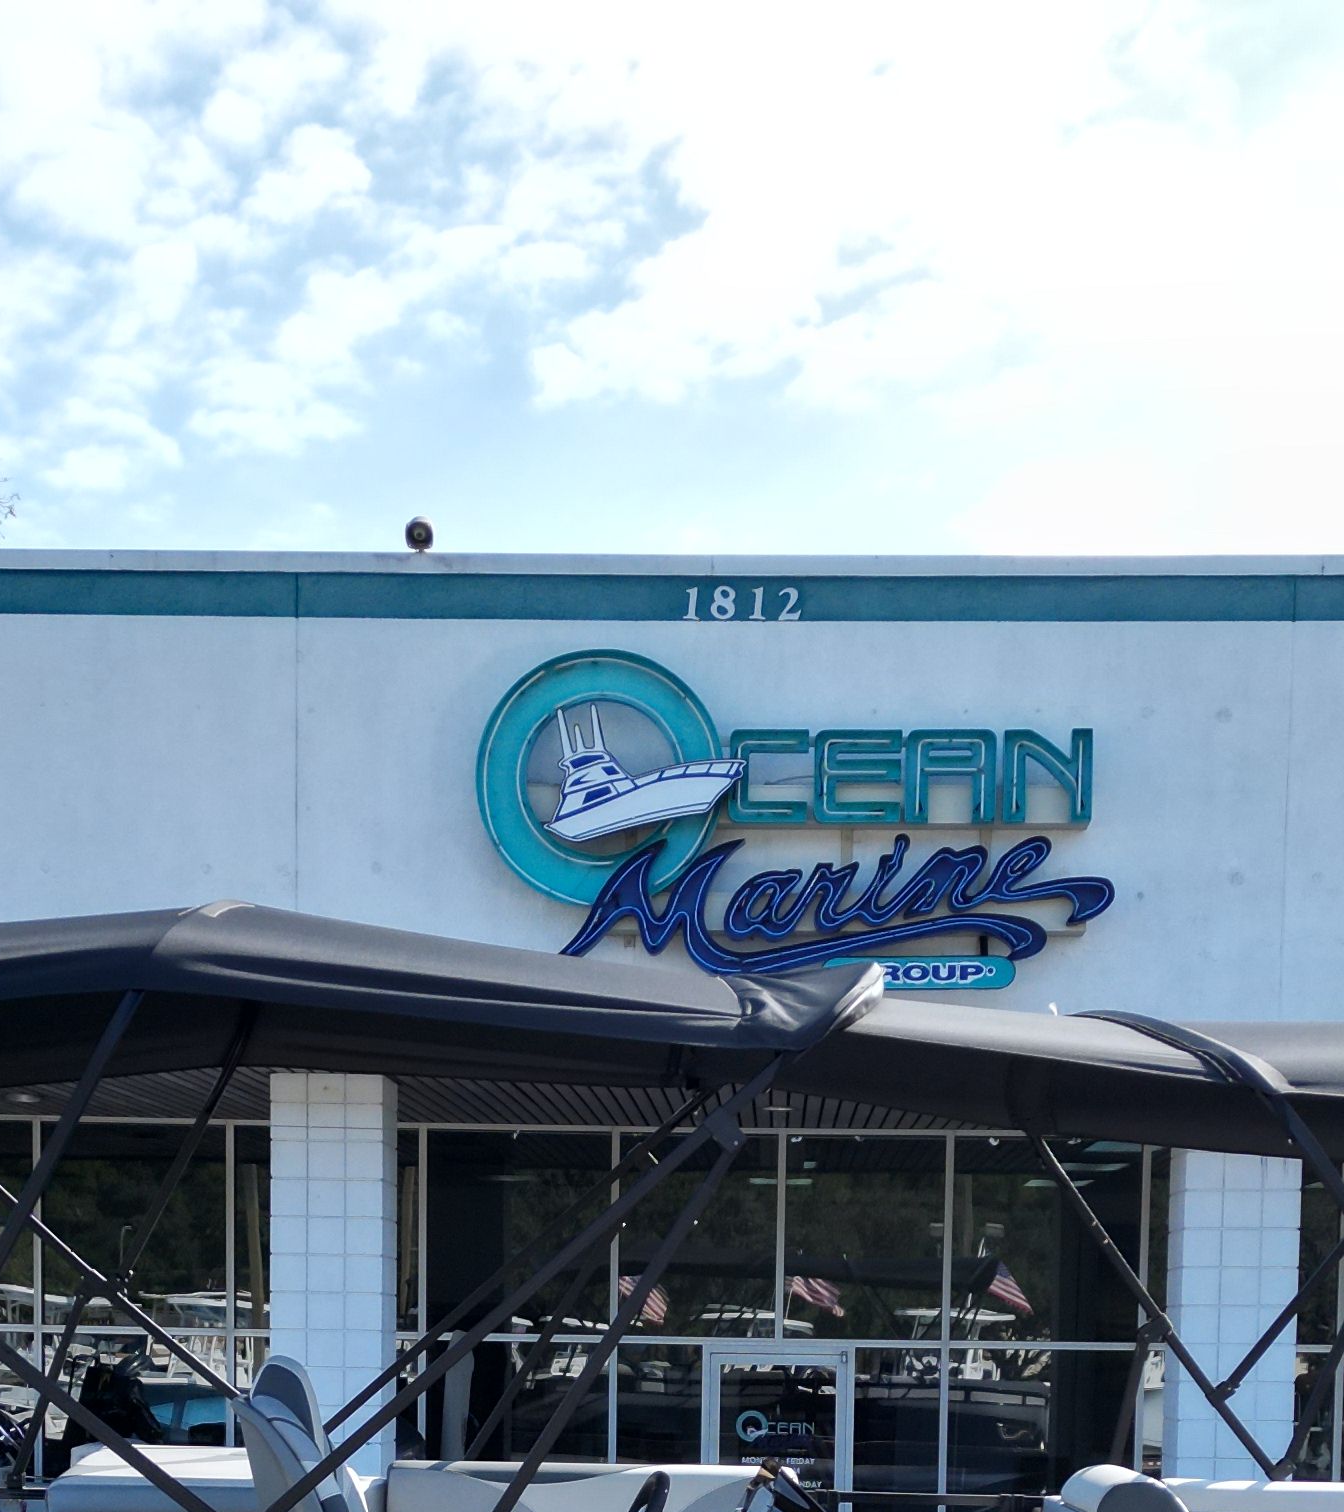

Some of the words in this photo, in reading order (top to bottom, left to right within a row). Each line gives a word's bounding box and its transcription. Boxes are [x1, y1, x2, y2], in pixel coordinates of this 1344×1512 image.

[682, 585, 802, 621] 1812
[475, 648, 1094, 906] OCEAN
[559, 834, 1116, 975] Marine
[880, 962, 986, 984] ROUP
[736, 1410, 815, 1442] OCEAN
